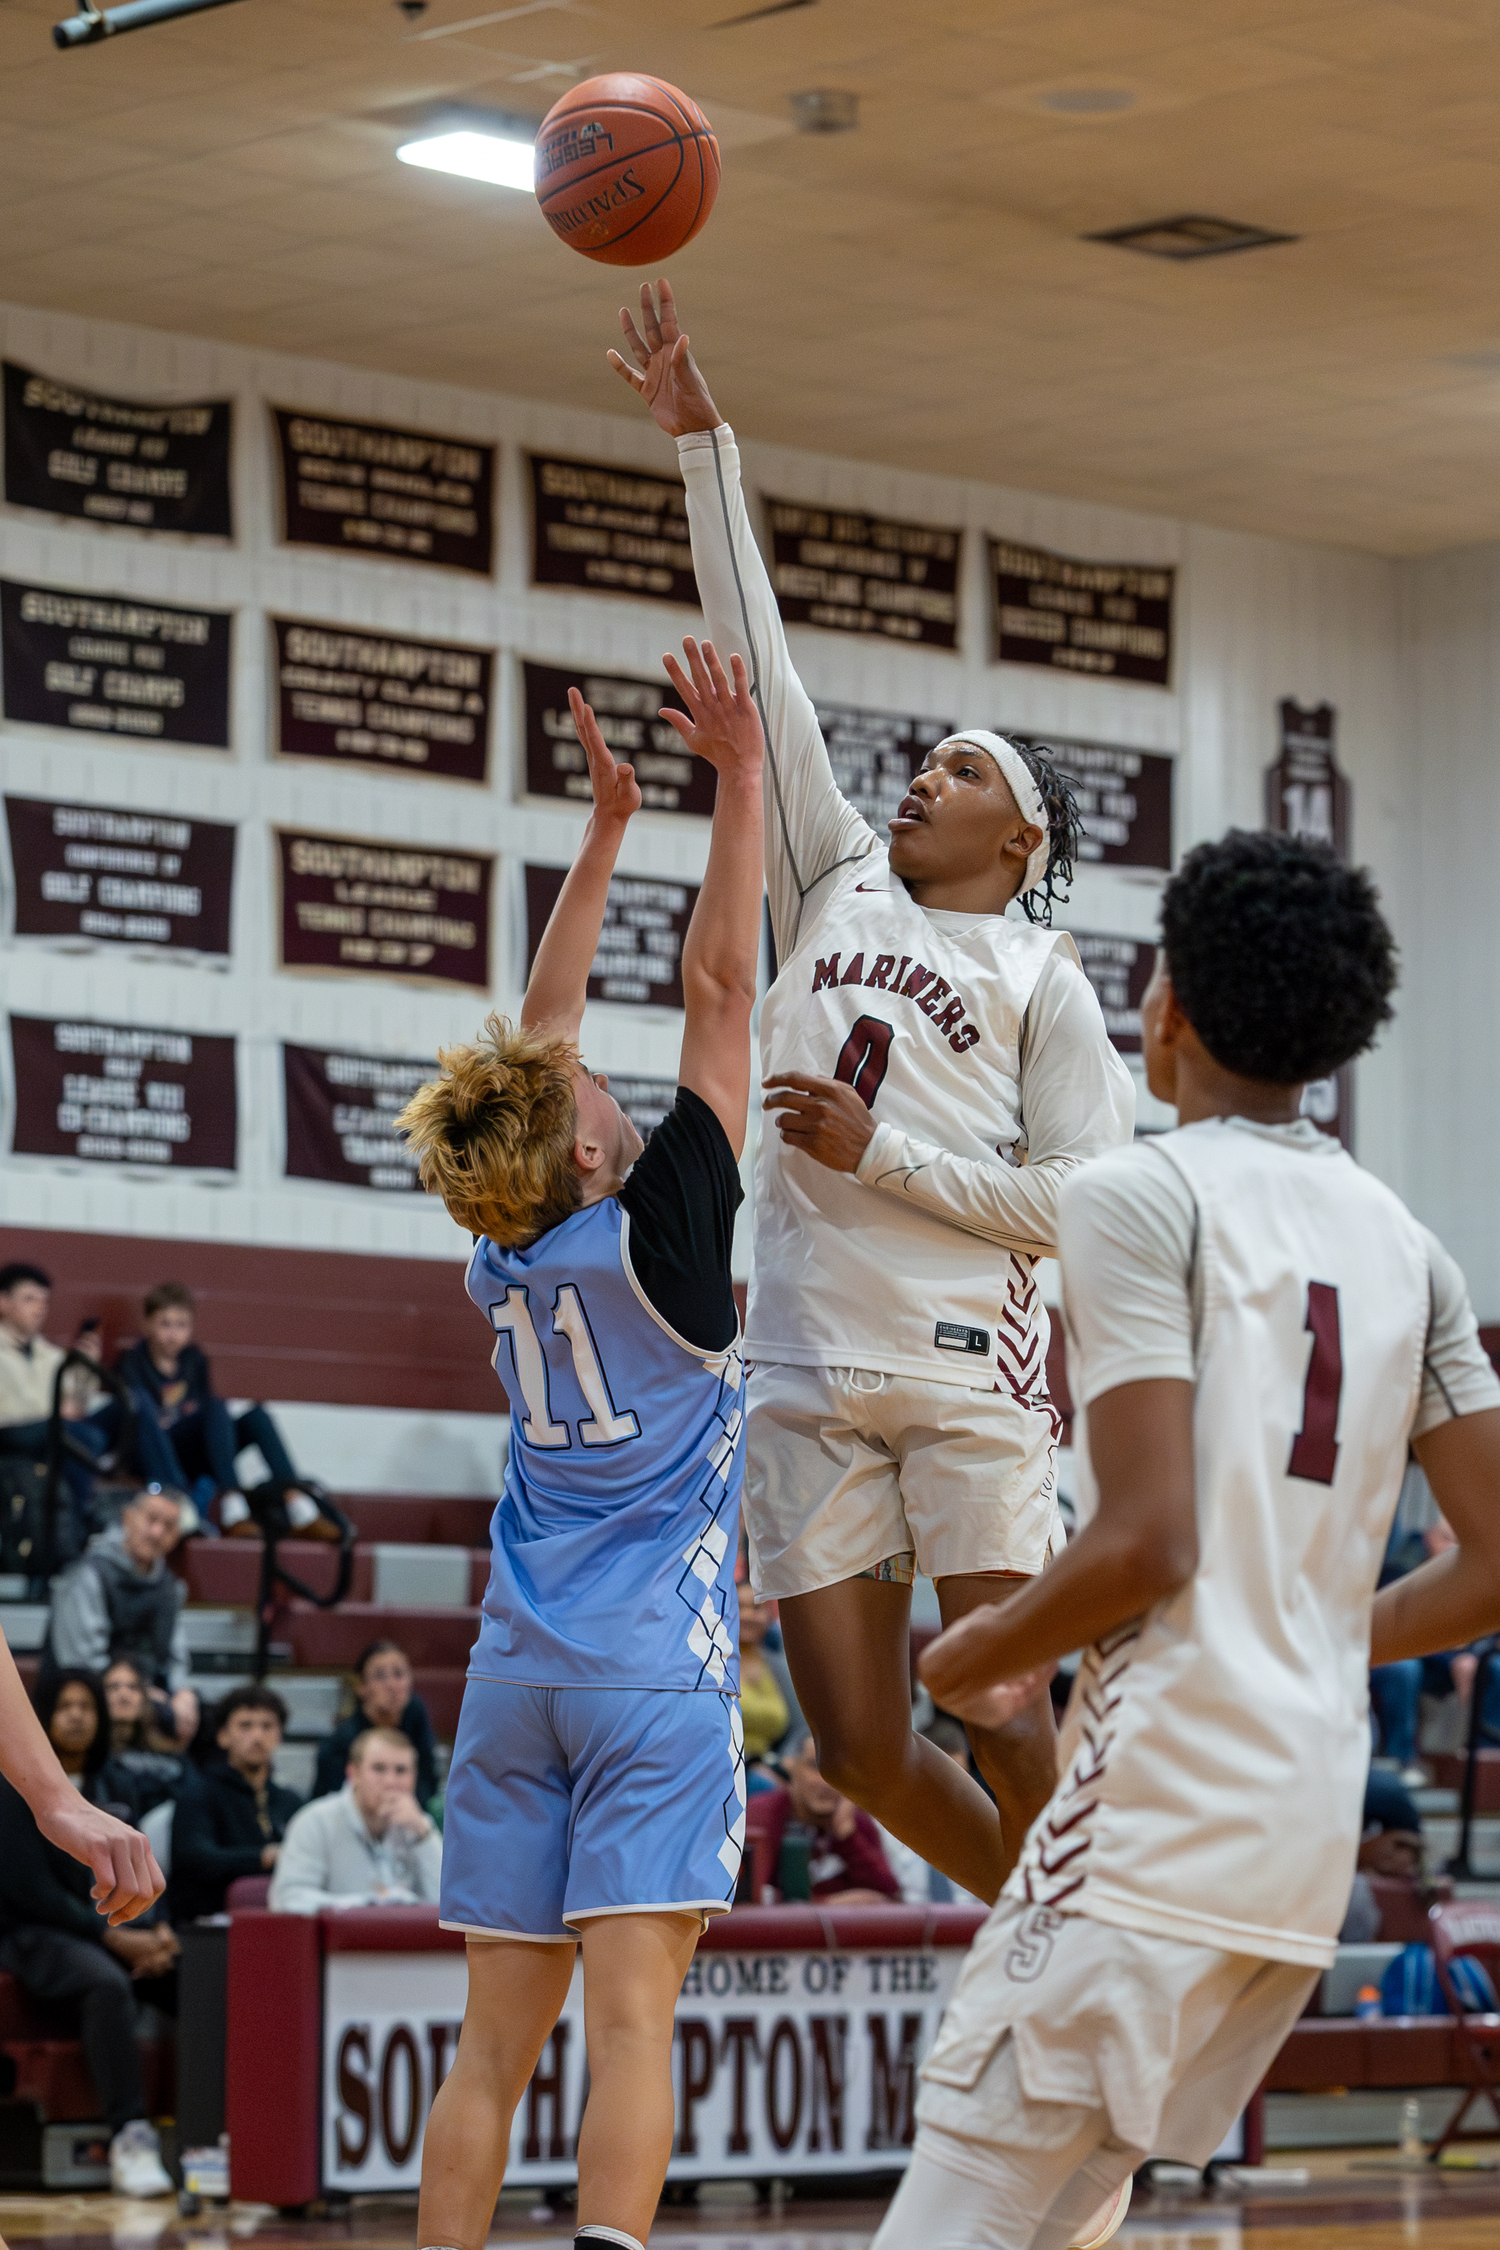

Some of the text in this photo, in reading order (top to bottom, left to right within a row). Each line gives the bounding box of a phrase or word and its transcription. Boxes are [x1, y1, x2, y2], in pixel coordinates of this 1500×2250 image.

[811, 951, 981, 1054] MARINERS
[833, 1013, 896, 1110] 0
[489, 1282, 642, 1450] 11
[975, 1335, 982, 1347] L
[1285, 1279, 1344, 1488] 1
[681, 1953, 937, 1997] HOME OF THE
